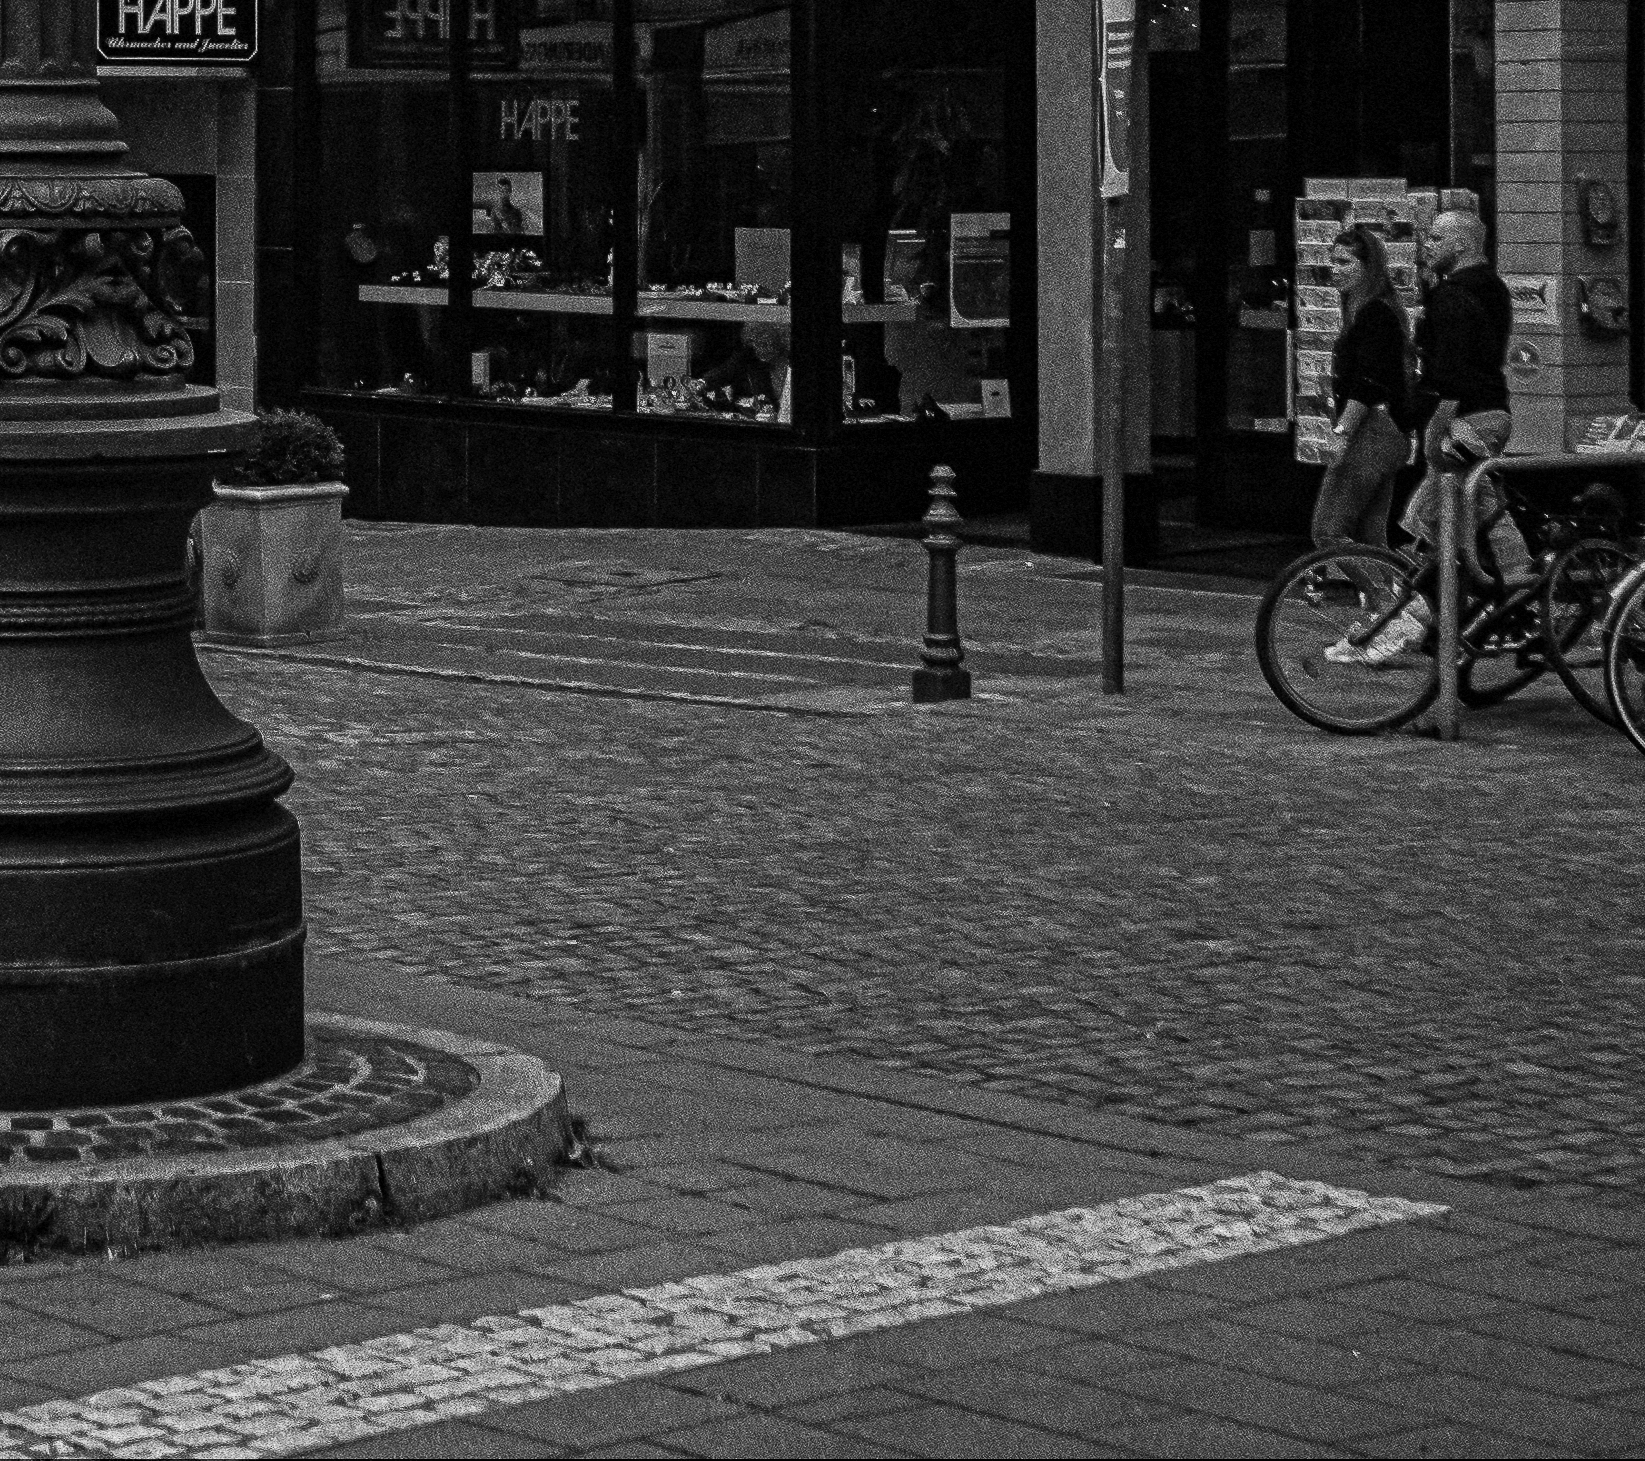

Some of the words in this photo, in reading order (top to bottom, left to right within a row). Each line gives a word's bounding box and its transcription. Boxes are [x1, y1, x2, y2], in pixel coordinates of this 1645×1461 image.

[106, 36, 172, 50] Uhrmacher
[174, 37, 200, 50] und
[198, 38, 249, 54] Juwelier
[499, 99, 580, 141] HAPPE
